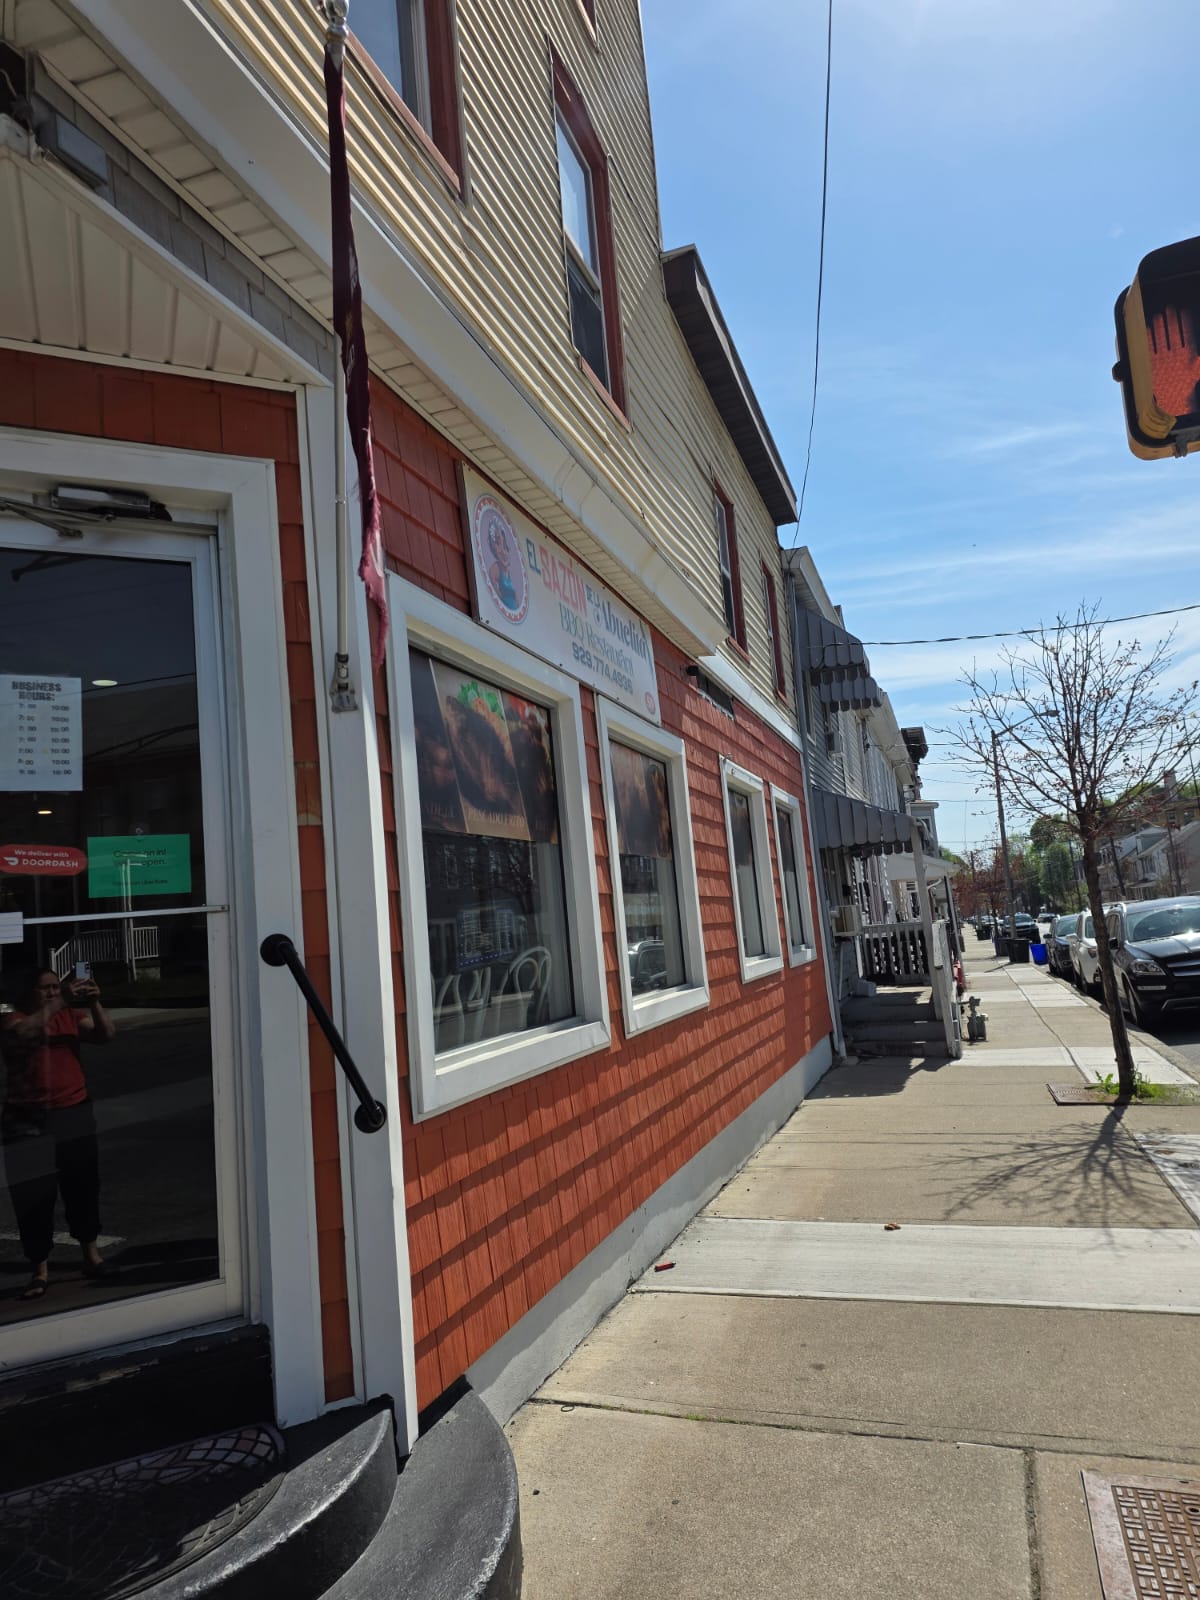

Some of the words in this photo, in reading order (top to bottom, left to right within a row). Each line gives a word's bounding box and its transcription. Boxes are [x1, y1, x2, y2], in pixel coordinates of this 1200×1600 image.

[525, 537, 541, 575] EL
[538, 545, 587, 615] SAZÓN
[594, 601, 648, 661] Abuelita
[559, 602, 585, 643] BBQ
[11, 681, 62, 692] BUSINESS
[18, 691, 56, 701] HOURS:
[22, 860, 79, 868] DOORDASH
